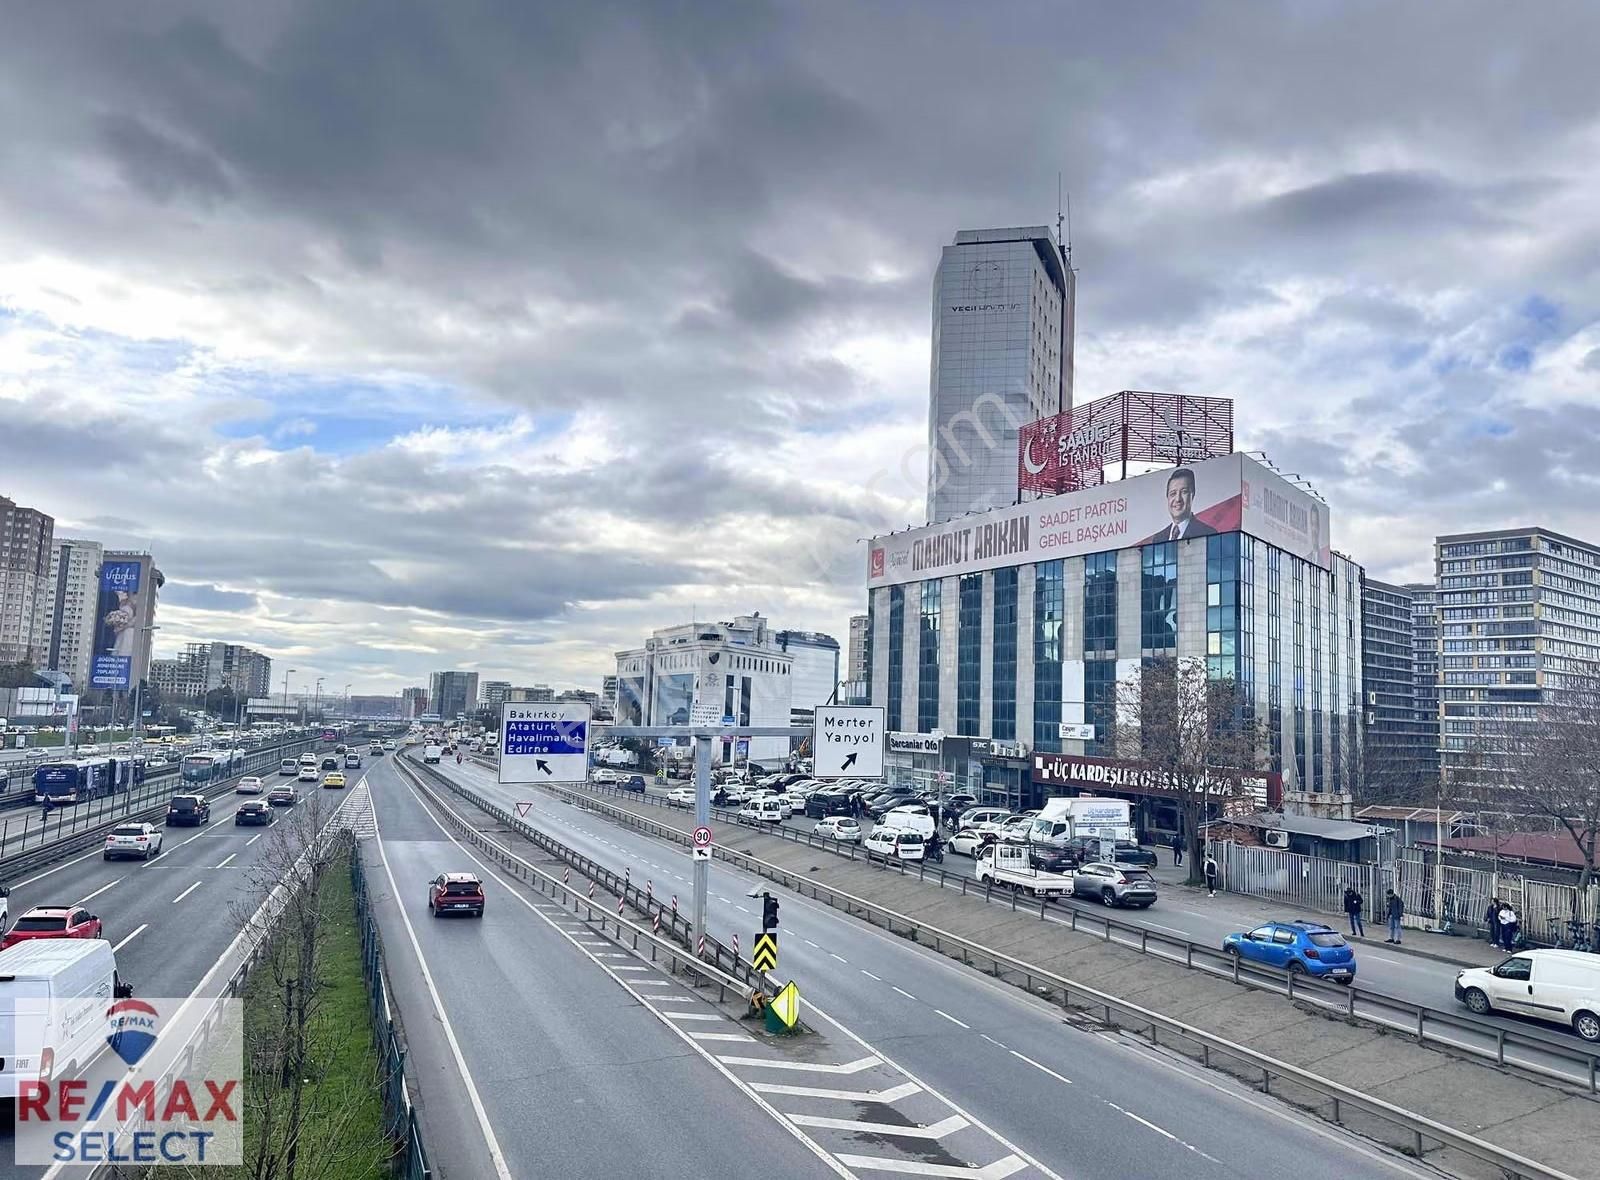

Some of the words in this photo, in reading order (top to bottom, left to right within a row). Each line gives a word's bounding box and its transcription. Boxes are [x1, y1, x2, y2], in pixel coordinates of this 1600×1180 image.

[1039, 508, 1082, 529] SAADET
[1039, 531, 1073, 549] GENEL
[1077, 520, 1127, 543] BAŞKANI
[912, 528, 971, 571] MAHMUT
[974, 515, 1030, 560] ARIKAN
[509, 722, 557, 731] Atatürk
[824, 717, 873, 728] Merter
[508, 733, 571, 742] Havalimanı
[825, 732, 874, 746] Yanyol
[507, 744, 549, 754] Edirne
[1054, 758, 1069, 782] ÜÇ
[1070, 763, 1138, 788] KARDEŞLER
[697, 832, 708, 841] 90
[16, 1058, 30, 1069] FIAT
